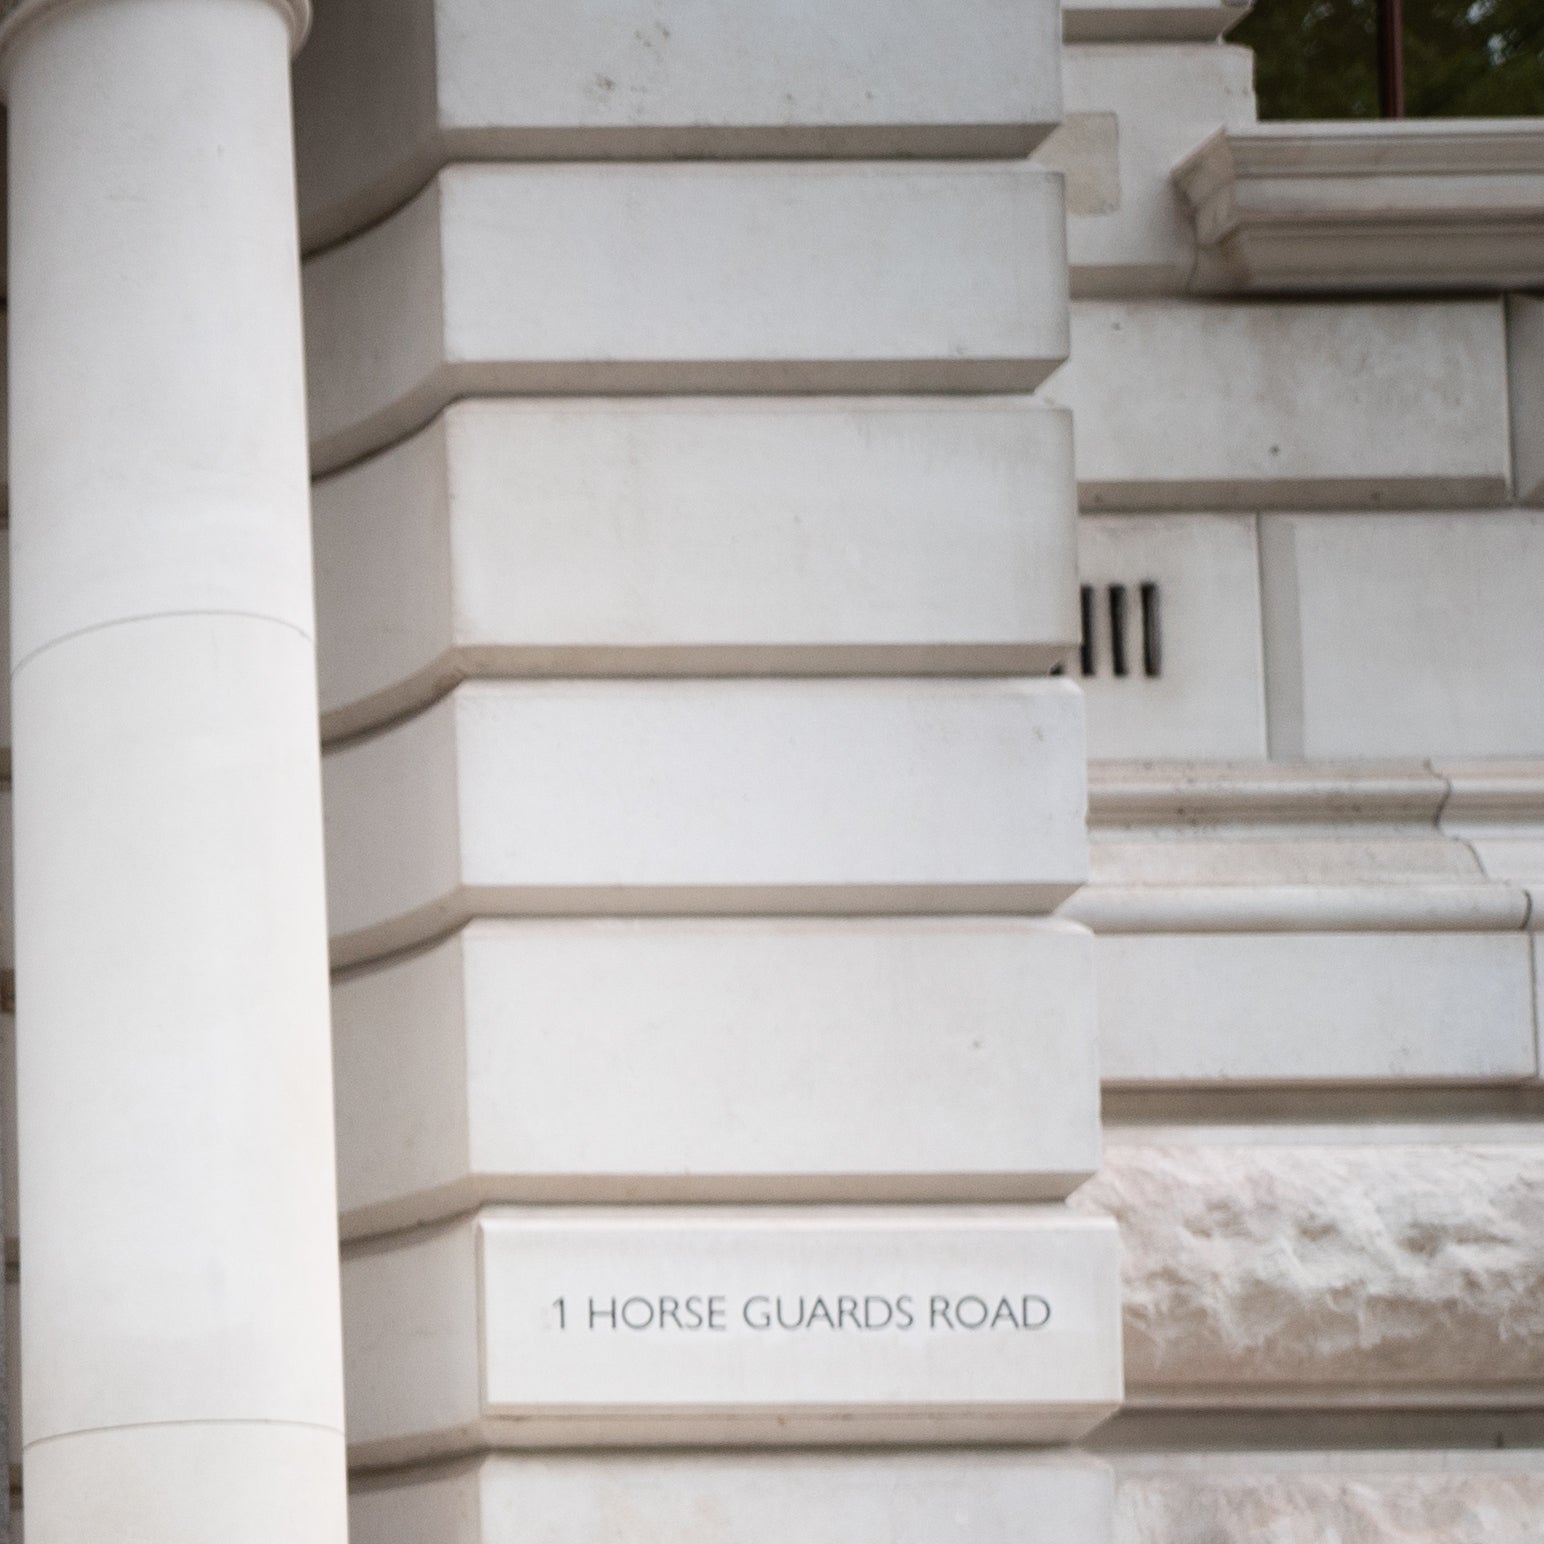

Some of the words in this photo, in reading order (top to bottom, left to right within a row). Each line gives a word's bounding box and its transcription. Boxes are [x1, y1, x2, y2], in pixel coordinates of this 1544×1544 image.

[552, 1297, 566, 1330] 1
[588, 1295, 727, 1331] HORSE
[743, 1295, 914, 1331] GUARDS
[929, 1295, 1052, 1330] ROAD
